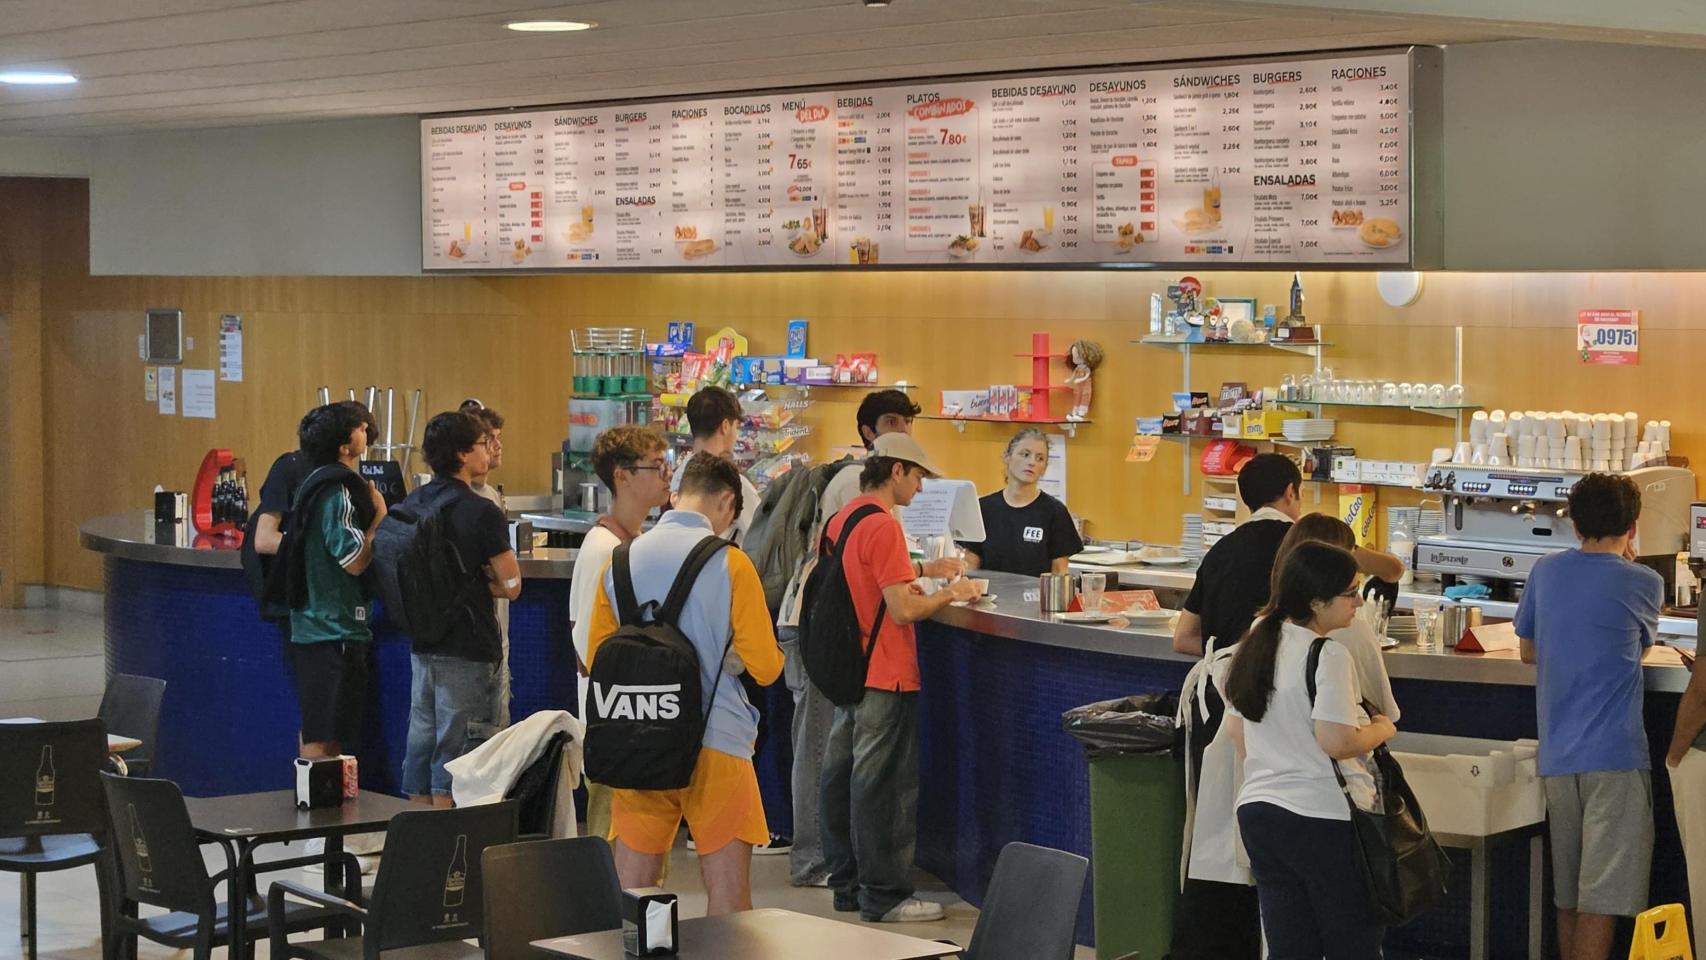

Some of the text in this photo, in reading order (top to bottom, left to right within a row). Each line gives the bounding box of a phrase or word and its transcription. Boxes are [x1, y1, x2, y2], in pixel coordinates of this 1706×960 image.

[1253, 71, 1302, 83] BURGERS
[1331, 66, 1386, 80] RACIONES
[1089, 80, 1146, 92] DESAYUNOS
[1173, 74, 1240, 88] SÁNDWICHES
[991, 84, 1077, 98] BEBIDAS DESAYUNO
[837, 97, 872, 108] BEBIDAS
[906, 93, 940, 103] PLATOS
[724, 104, 771, 115] BOCADILLOS
[782, 98, 805, 111] MENÚ
[615, 112, 647, 123] BURGERS
[672, 108, 707, 119] RACIONES
[495, 120, 532, 131] DESAYUNOS
[554, 115, 598, 127] SÁNDWICHES
[431, 123, 487, 136] BEBIDAS DESAYUNO
[1254, 174, 1316, 186] ENSALADAS
[616, 196, 656, 206] ENSALADAS
[1597, 328, 1637, 345] 09751
[784, 401, 808, 410] HALLS
[971, 398, 989, 409] buen
[1344, 496, 1363, 527] laCao
[1025, 528, 1041, 538] FEE
[593, 681, 681, 720] VANS
